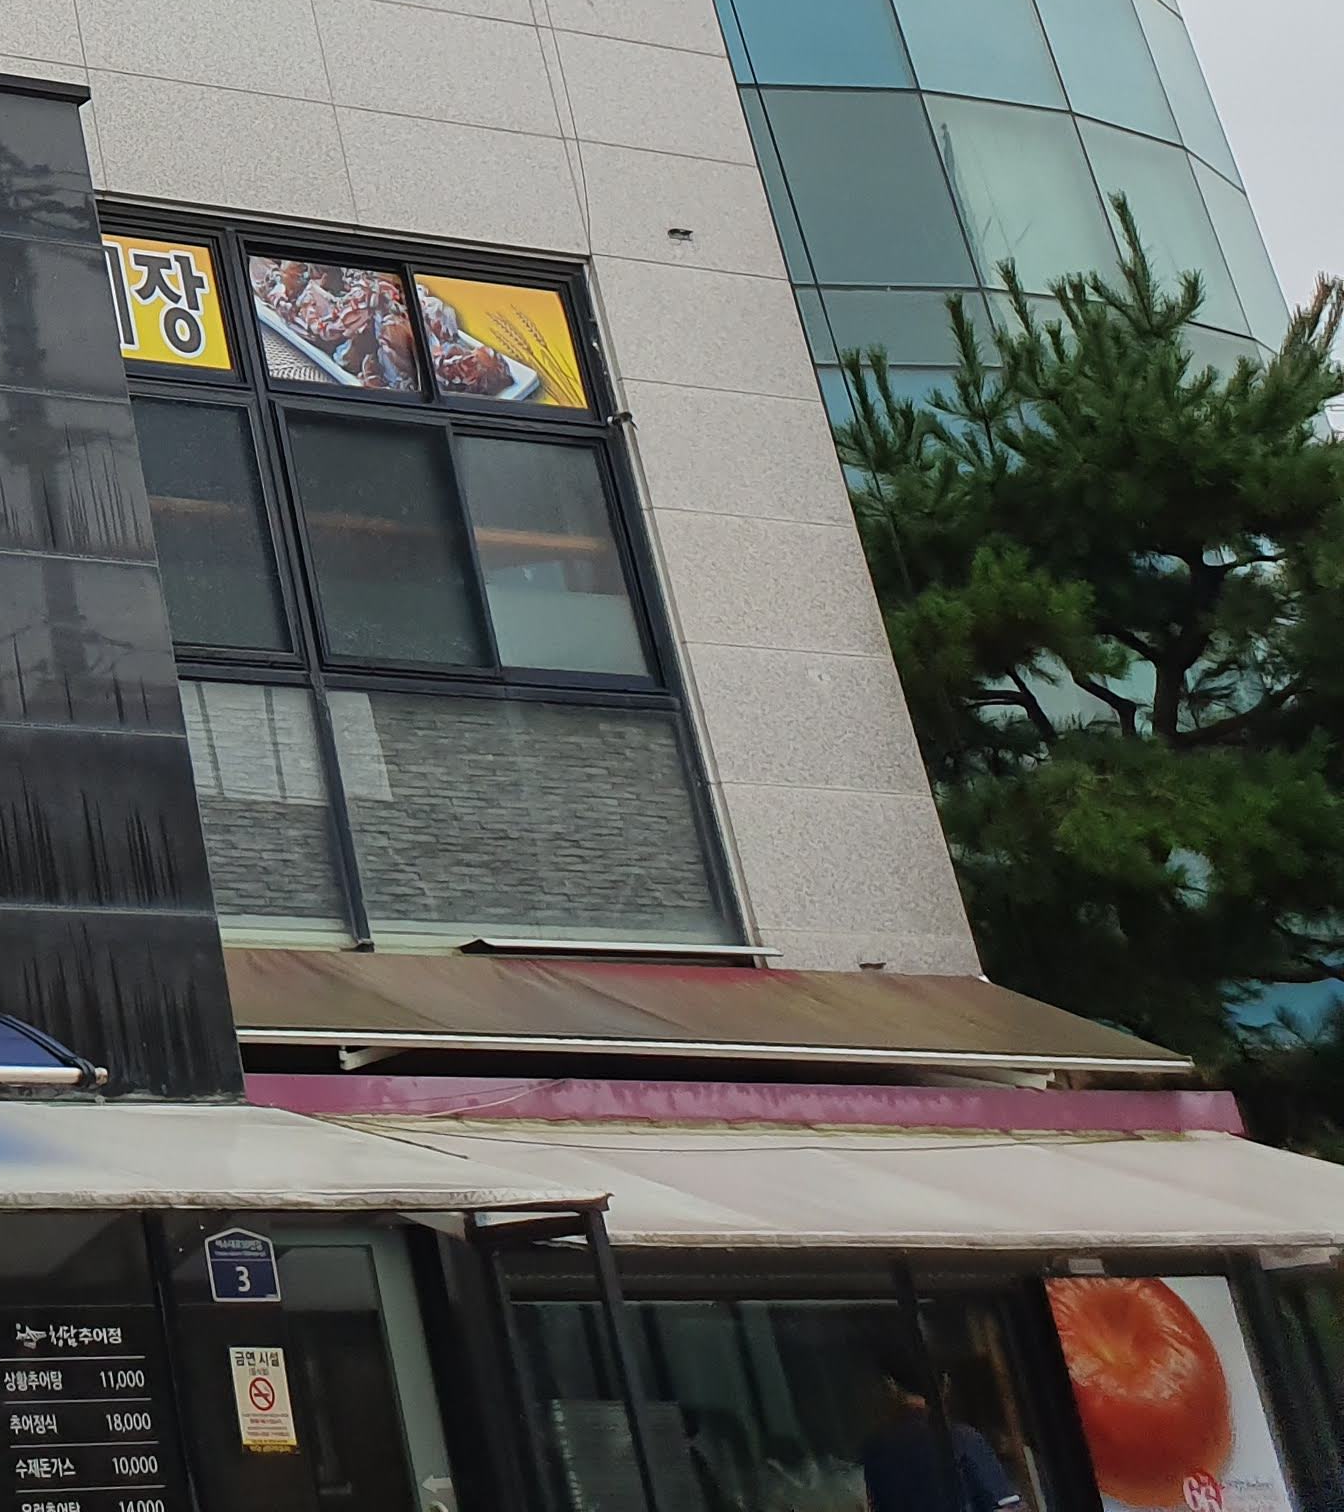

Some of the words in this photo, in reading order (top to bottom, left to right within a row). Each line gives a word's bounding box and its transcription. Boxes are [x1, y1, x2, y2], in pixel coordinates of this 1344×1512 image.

[235, 1265, 251, 1293] 3
[235, 1351, 256, 1367] 금연
[259, 1351, 280, 1367] 시설
[4, 1370, 63, 1392] 상황추어탕
[100, 1370, 145, 1390] 11,000
[9, 1413, 58, 1435] 추어정식
[106, 1412, 152, 1433] 18,000
[15, 1457, 77, 1479] 수제돈가스
[111, 1456, 158, 1477] 10,000
